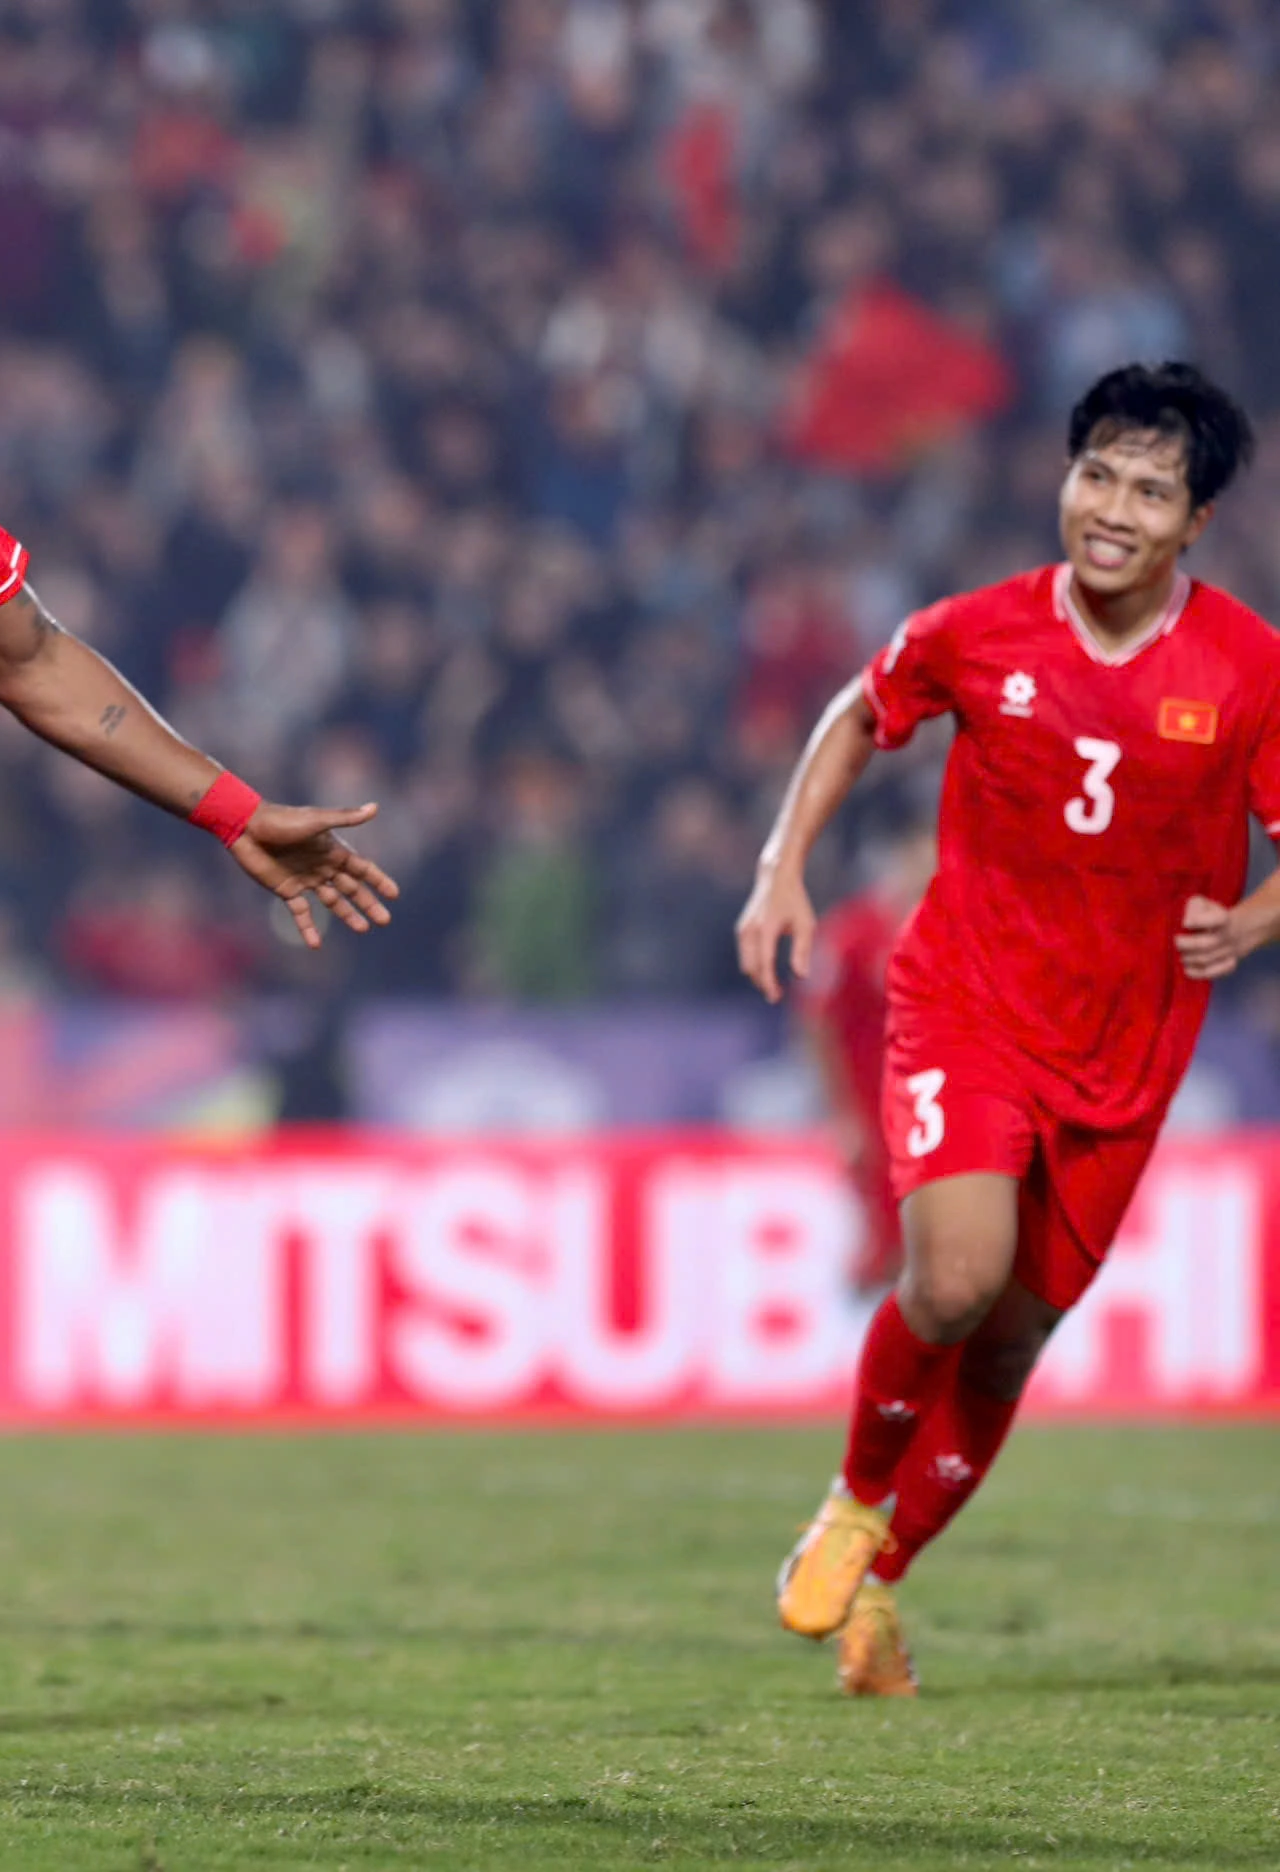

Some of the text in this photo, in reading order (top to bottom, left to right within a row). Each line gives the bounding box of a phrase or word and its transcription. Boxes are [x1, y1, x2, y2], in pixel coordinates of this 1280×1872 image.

[1063, 735, 1121, 835] 3
[906, 1068, 946, 1158] 3
[17, 1157, 1257, 1400] MITSUBHI
